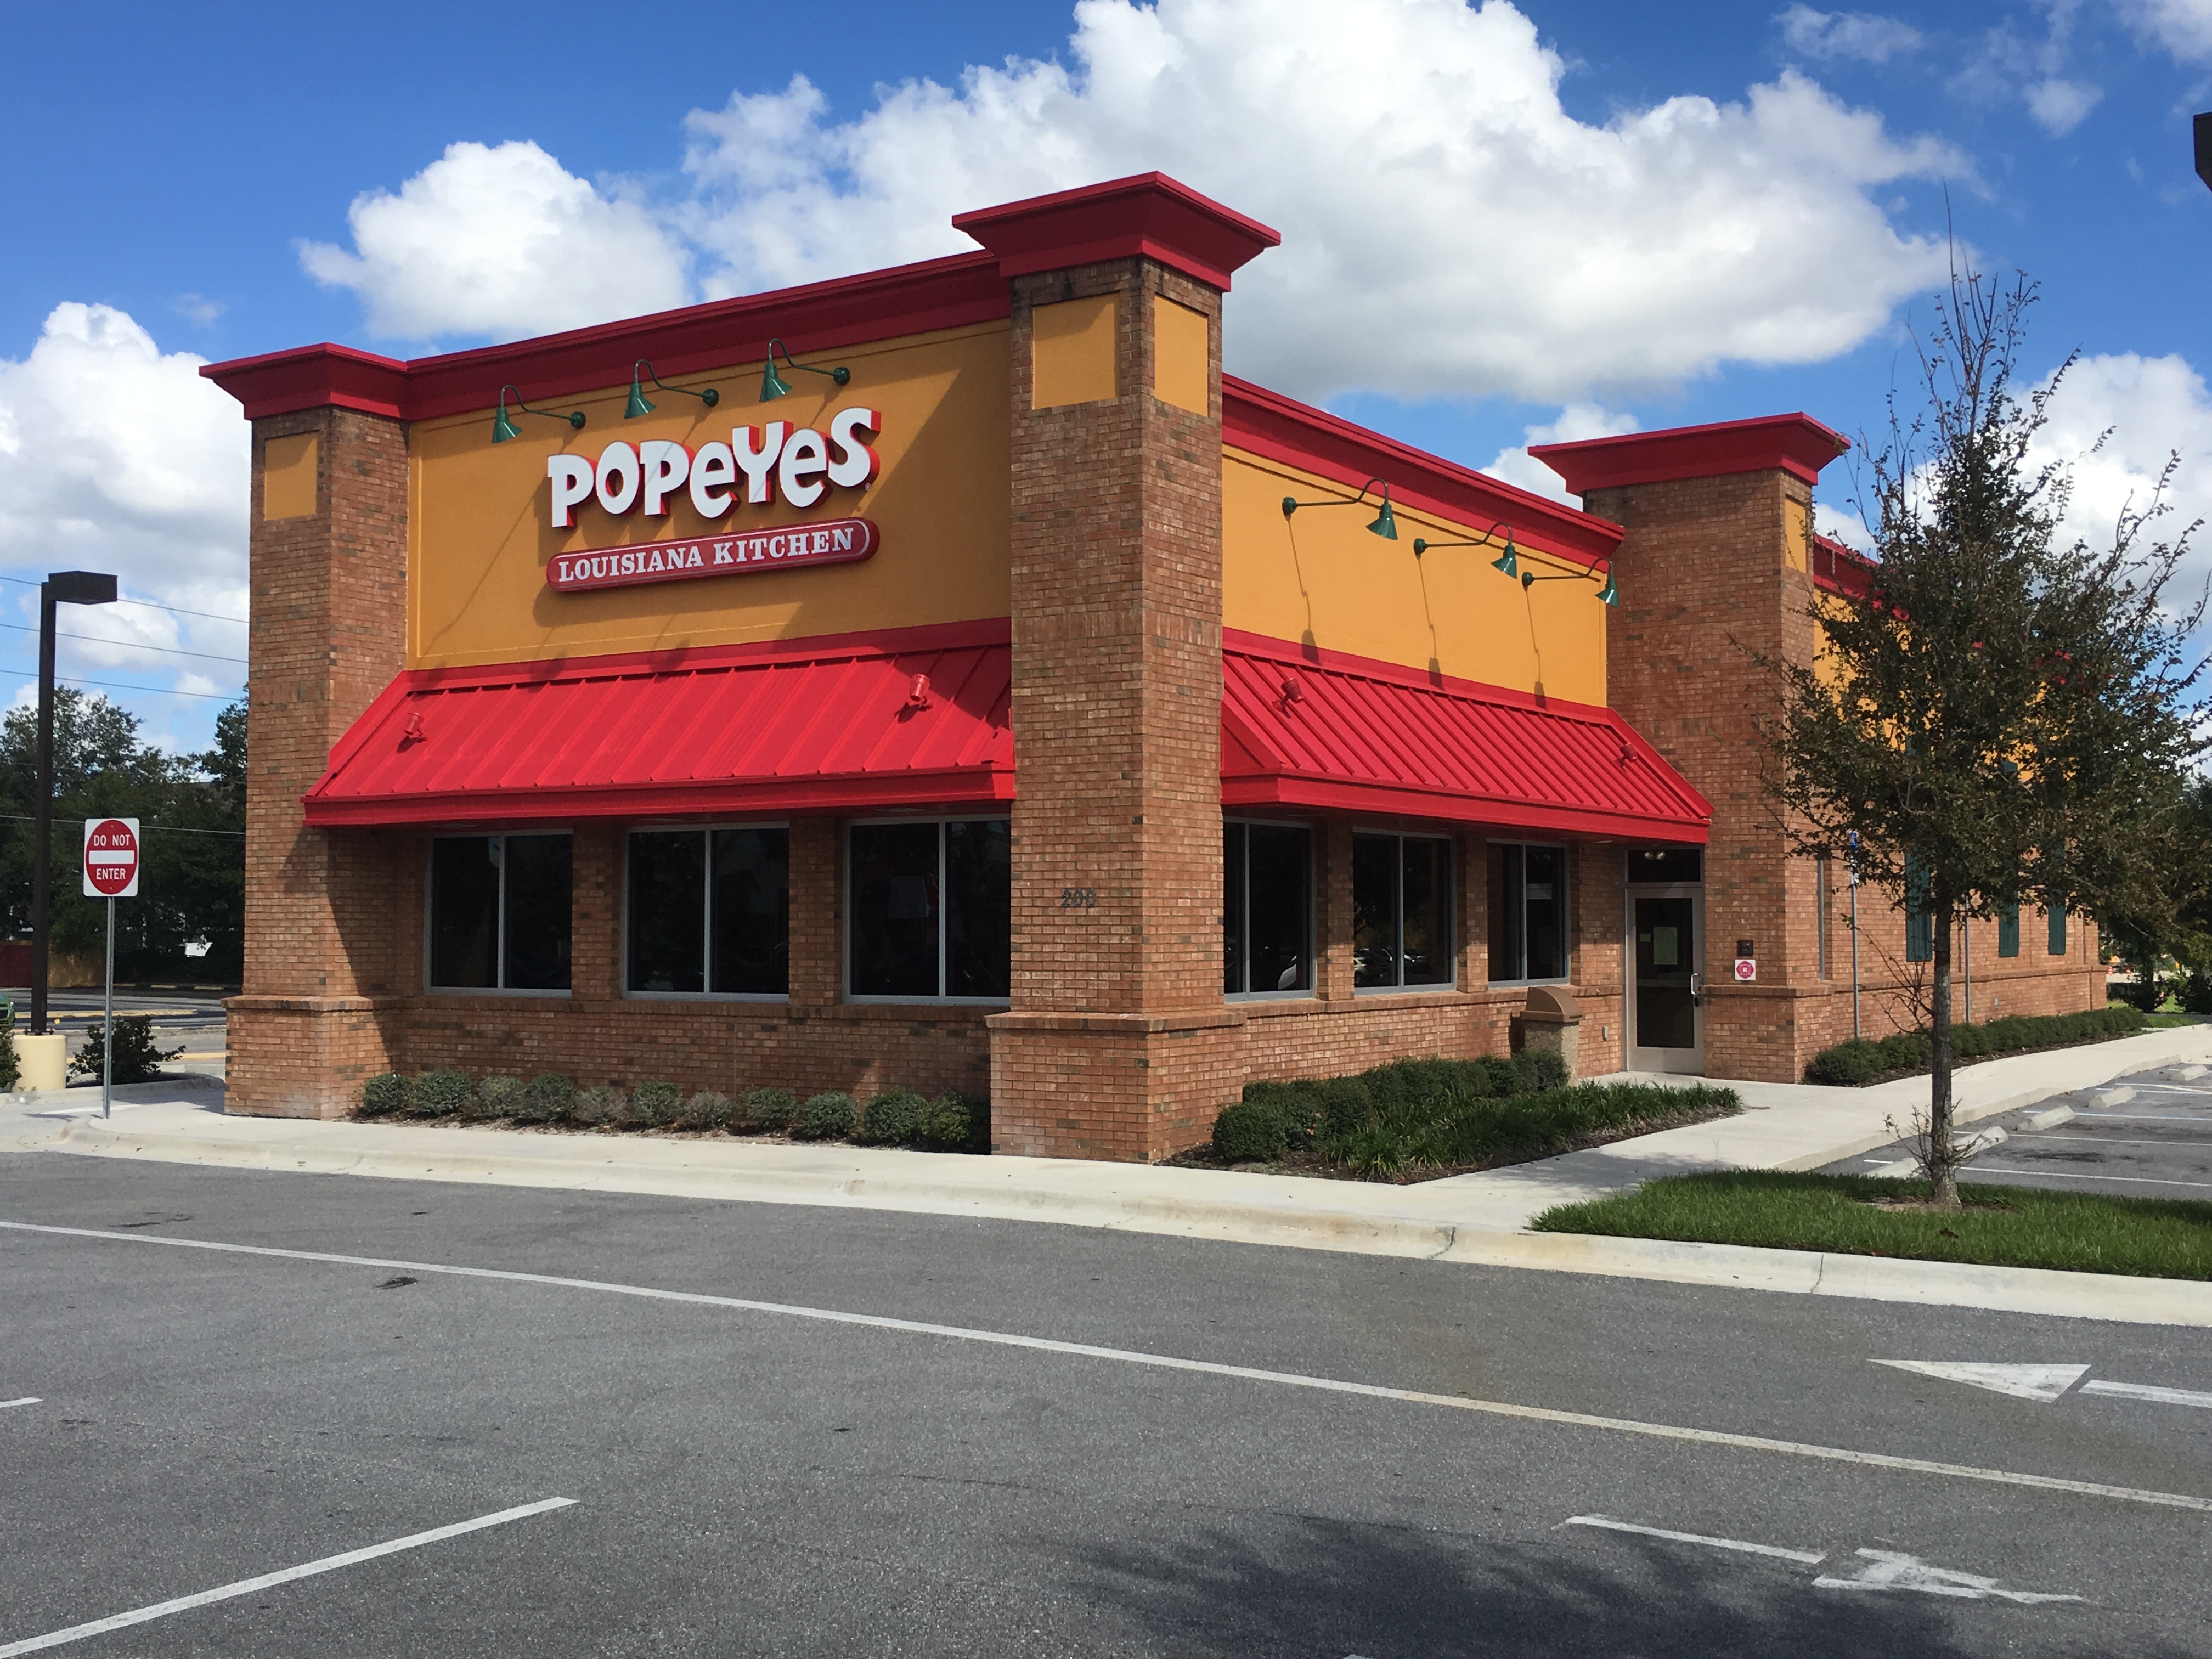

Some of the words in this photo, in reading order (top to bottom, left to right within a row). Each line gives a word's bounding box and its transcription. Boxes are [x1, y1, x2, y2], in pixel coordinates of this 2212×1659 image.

[558, 546, 704, 582] LOUISIANA
[713, 528, 854, 565] KITCHEN
[93, 834, 106, 847] DO
[112, 834, 131, 847] NOT
[96, 868, 126, 880] ENTER
[1060, 888, 1097, 908] 200
